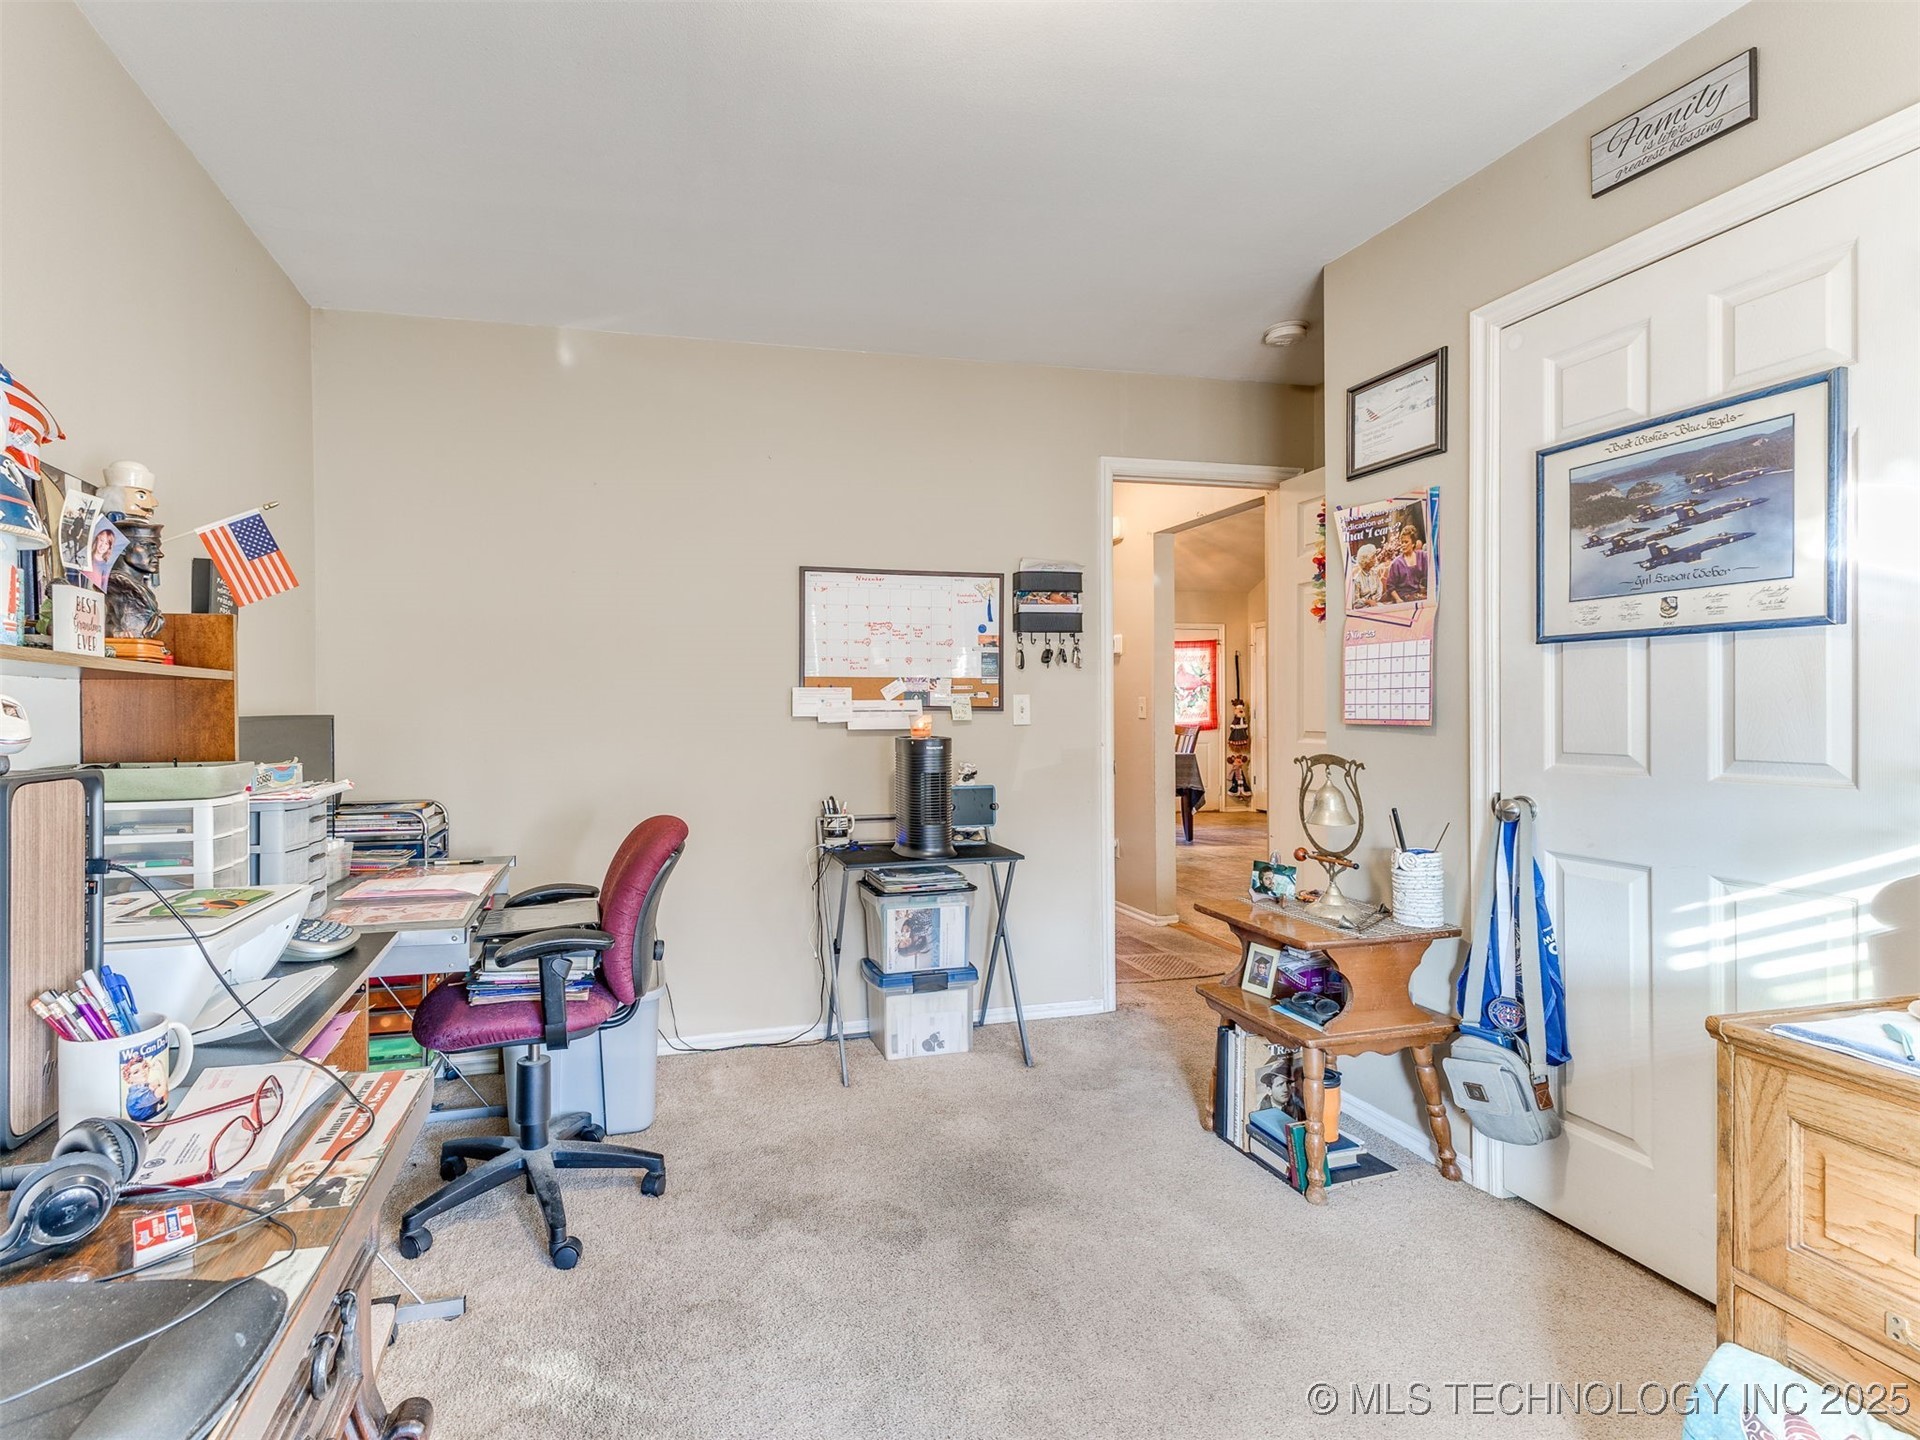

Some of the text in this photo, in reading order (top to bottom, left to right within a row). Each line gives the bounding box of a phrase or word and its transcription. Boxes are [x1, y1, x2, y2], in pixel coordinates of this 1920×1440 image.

[1607, 84, 1729, 159] Family
[1614, 117, 1724, 182] greatest blessing
[1642, 123, 1688, 153] is life's
[1605, 413, 1737, 454] Best Wishes Blue Angels
[1374, 521, 1402, 537] care?
[1653, 572, 1691, 584] Susan
[1693, 565, 1731, 580] Weber
[76, 595, 97, 615] BEST
[77, 633, 97, 652] EVER
[121, 1048, 139, 1061] We
[140, 1043, 157, 1056] Can
[156, 1036, 166, 1048] Do
[340, 1112, 371, 1140] Proud
[368, 1080, 393, 1103] Serve
[315, 1111, 351, 1145] Woman
[61, 1204, 78, 1225] logi
